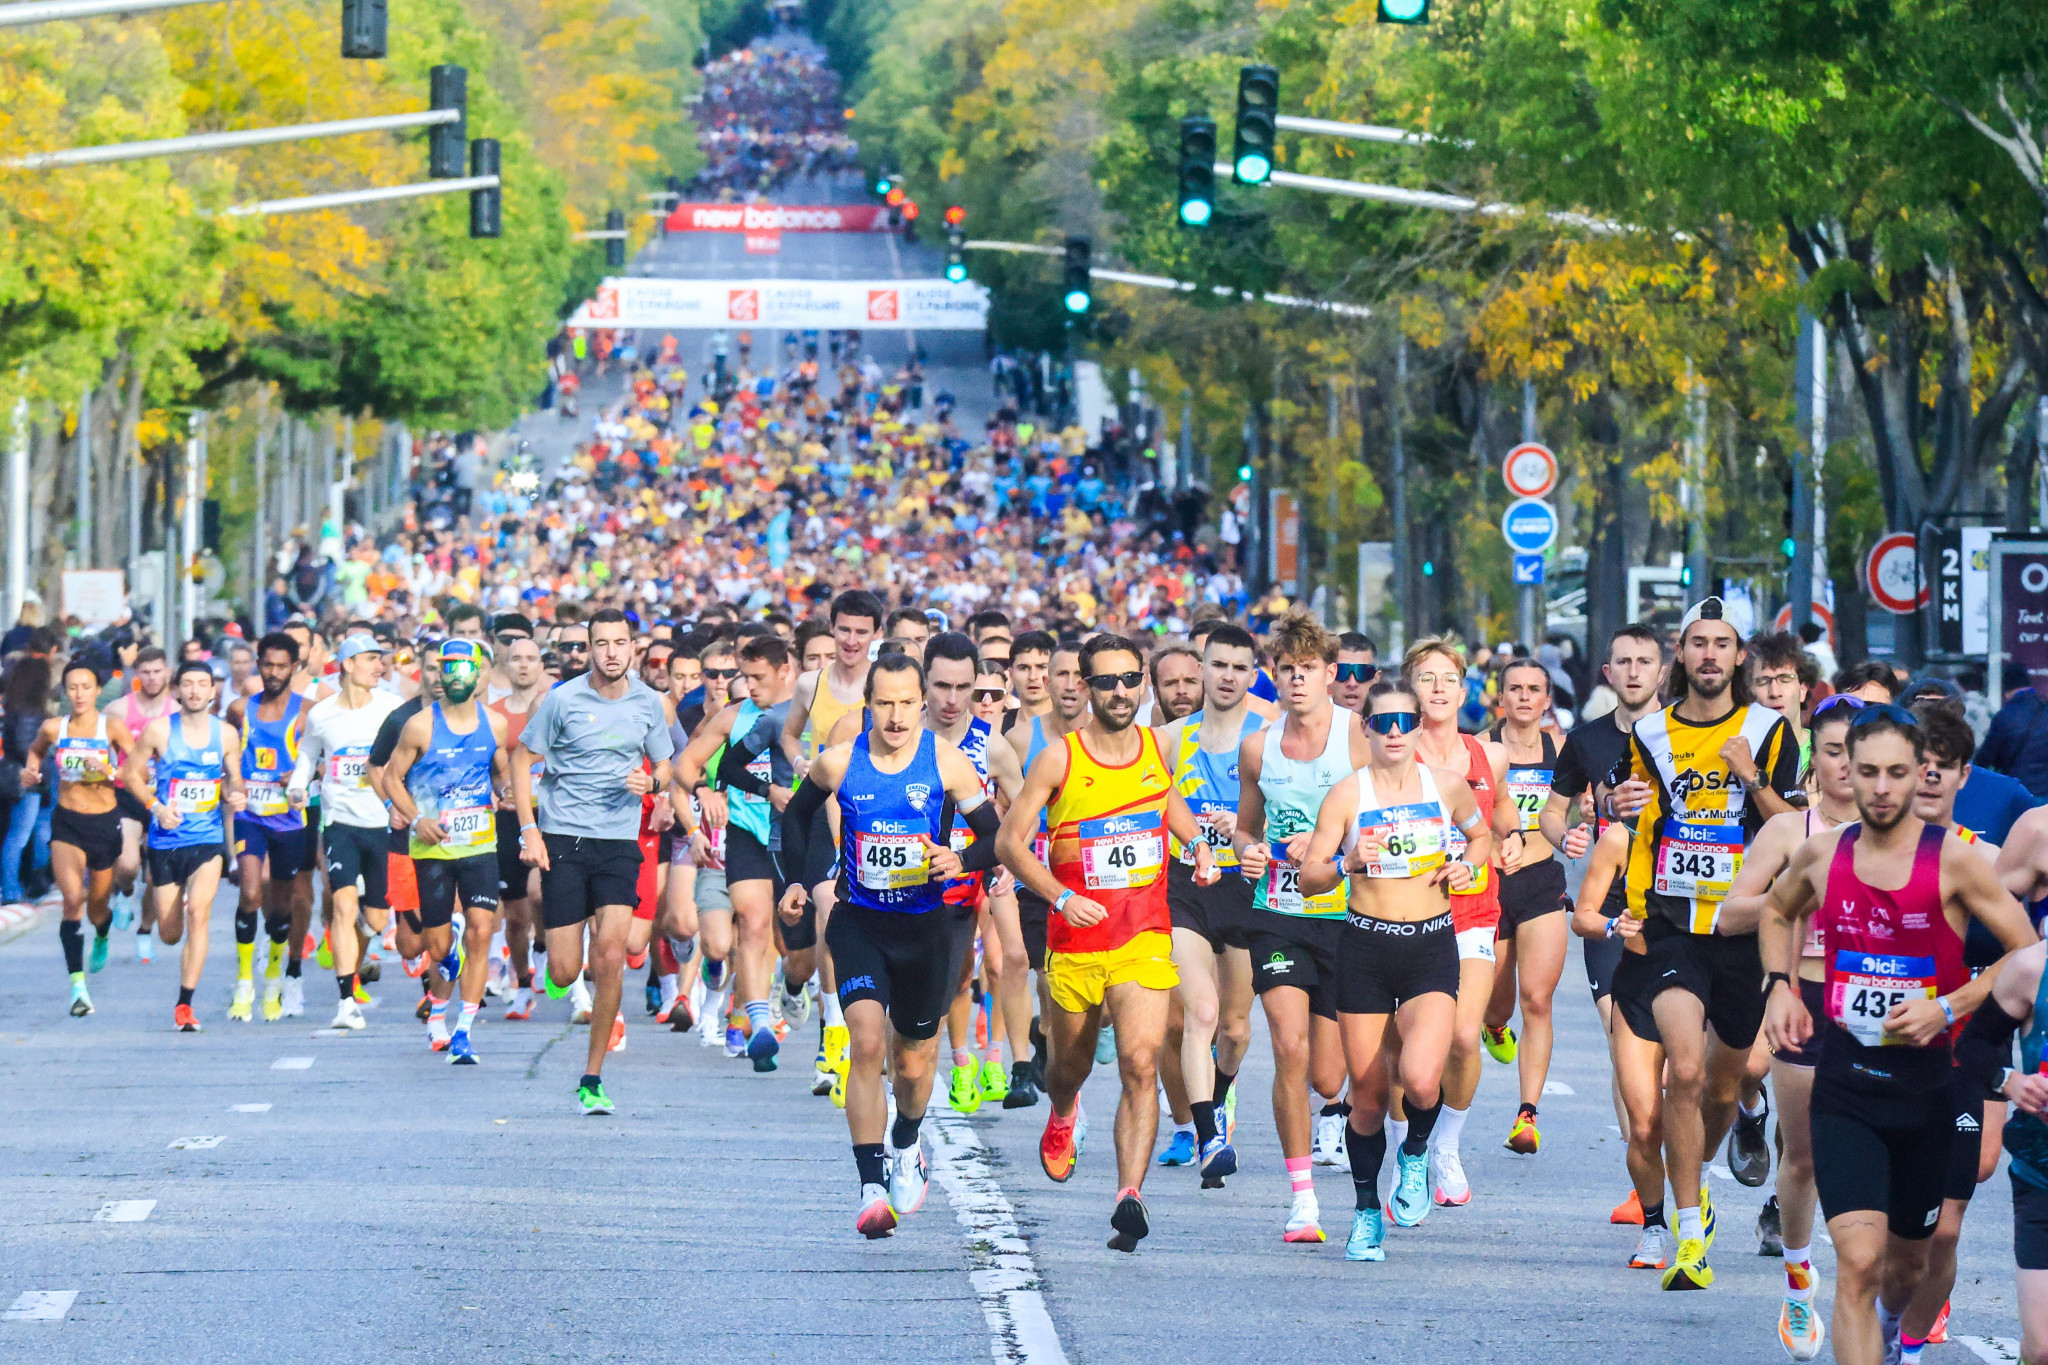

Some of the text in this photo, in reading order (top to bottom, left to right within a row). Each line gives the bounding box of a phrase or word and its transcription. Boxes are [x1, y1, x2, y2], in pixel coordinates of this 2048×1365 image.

[693, 206, 842, 229] new balance
[1508, 783, 1551, 792] new balanc
[1689, 770, 1742, 791] DSA
[180, 787, 205, 800] 451
[1517, 794, 1539, 812] 72
[1709, 808, 1747, 819] Mutuel
[454, 815, 479, 832] 6237
[882, 821, 898, 834] ici
[1115, 818, 1131, 833] ici
[863, 835, 919, 844] new balance
[1094, 831, 1152, 847] new balance
[1690, 827, 1707, 841] ici
[1387, 832, 1417, 856] 65
[1669, 840, 1729, 853] new balance
[866, 845, 907, 868] 485
[1108, 845, 1136, 868] 46
[1671, 852, 1715, 878] 343
[1373, 920, 1416, 936] PRO
[1422, 914, 1453, 934] NIKE
[1876, 958, 1896, 975] ici
[840, 975, 876, 998] NIKE
[1849, 975, 1922, 989] new balance
